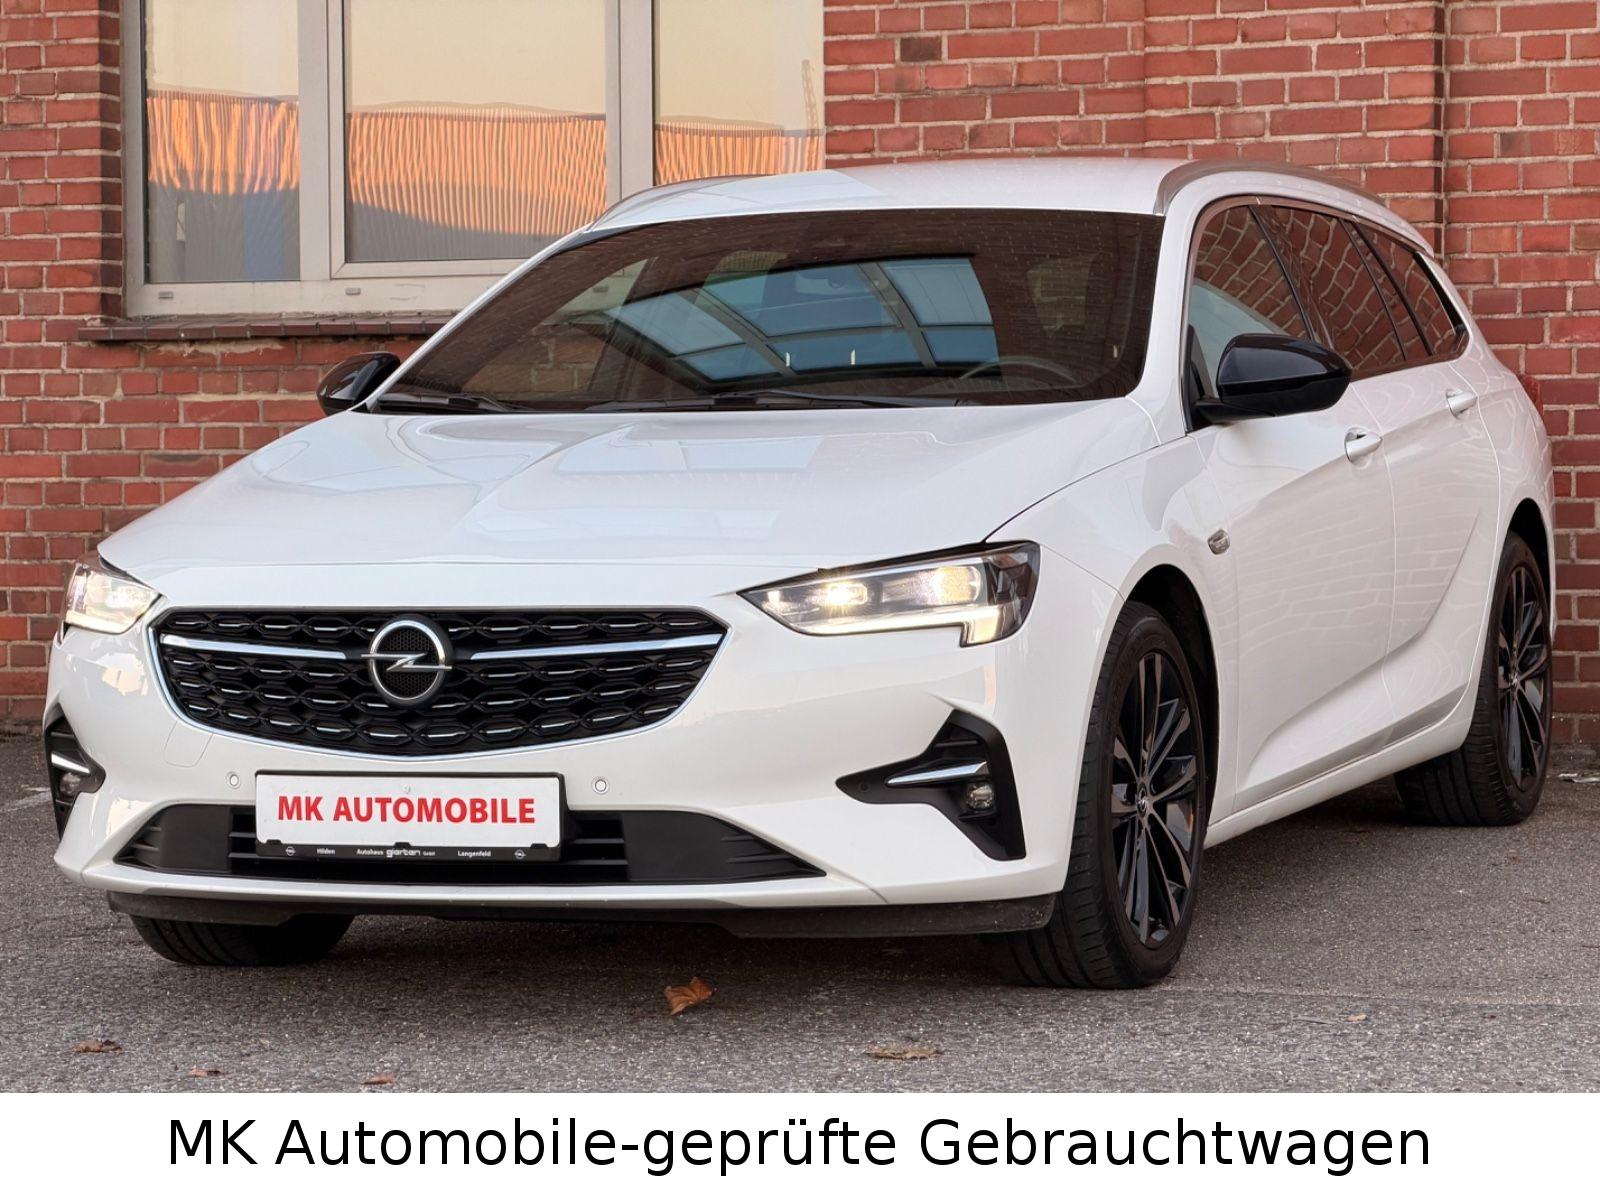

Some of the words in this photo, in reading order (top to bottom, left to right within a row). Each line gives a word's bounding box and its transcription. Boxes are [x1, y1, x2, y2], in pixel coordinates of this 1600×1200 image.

[278, 796, 323, 821] MK
[333, 797, 535, 824] AUTOMOBILE
[356, 848, 384, 856] Autohaus
[457, 850, 492, 859] Langenfeld
